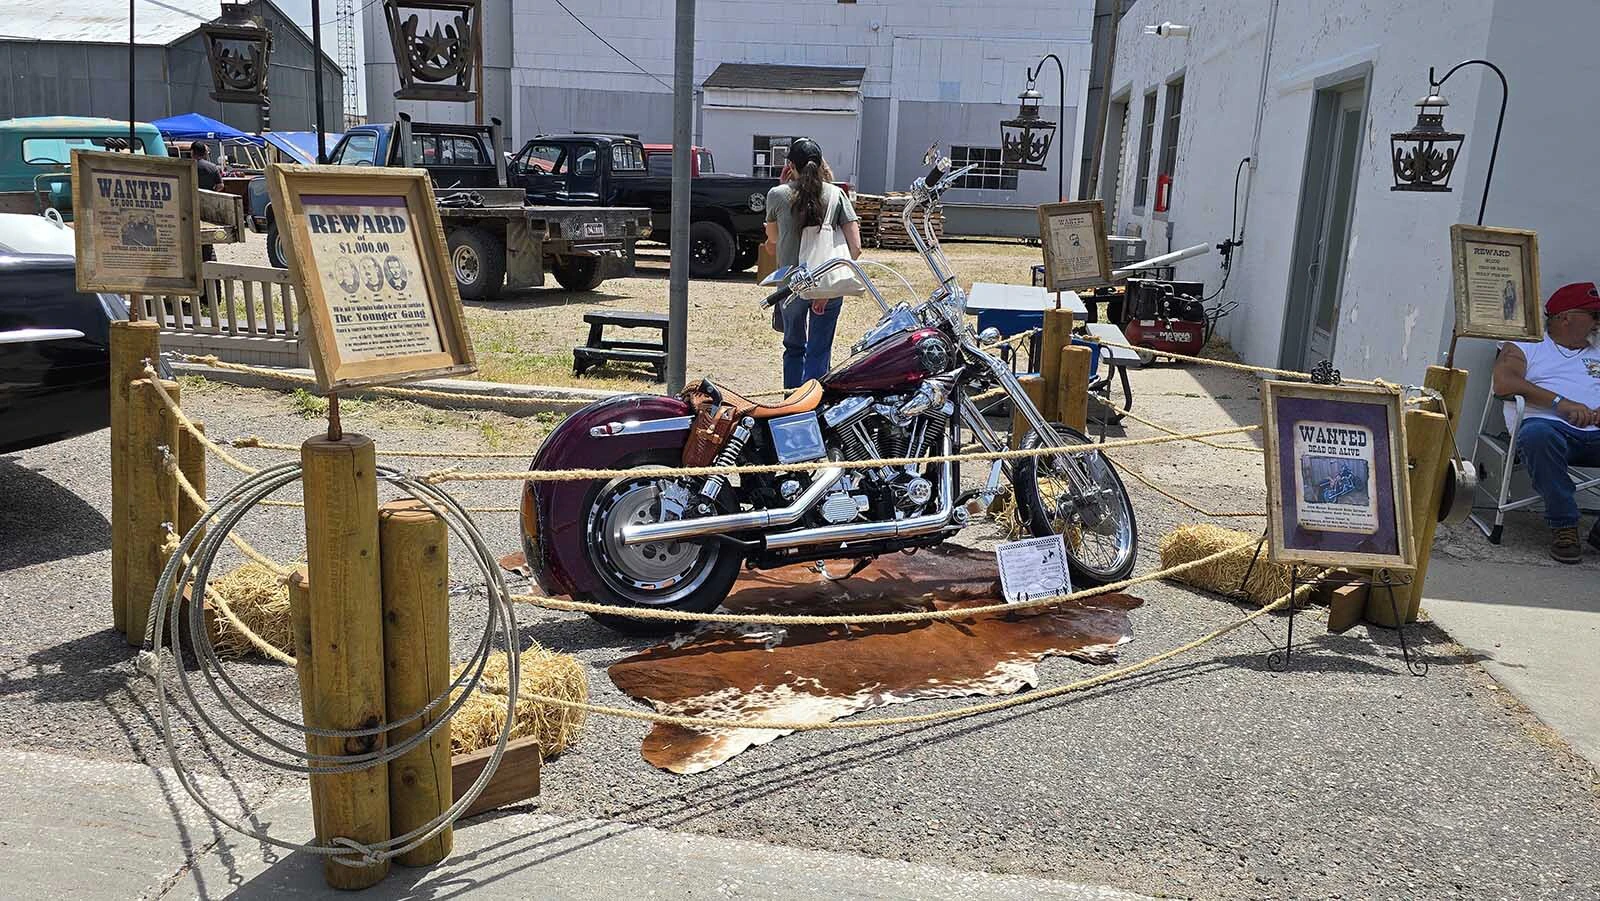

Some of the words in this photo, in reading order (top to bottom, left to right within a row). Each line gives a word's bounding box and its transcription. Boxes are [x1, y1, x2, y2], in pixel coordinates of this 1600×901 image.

[97, 178, 172, 201] WANTED
[135, 199, 164, 209] REWARD
[308, 214, 406, 234] REWARD
[339, 241, 390, 254] $1,000.00
[1473, 247, 1511, 257] REWARD
[334, 313, 352, 323] The
[356, 310, 398, 321] Younger
[401, 309, 426, 319] Gang
[1299, 425, 1367, 447] WANTED
[1308, 444, 1327, 454] DEAD
[1328, 446, 1337, 455] OR
[1339, 447, 1360, 456] ALIVE
